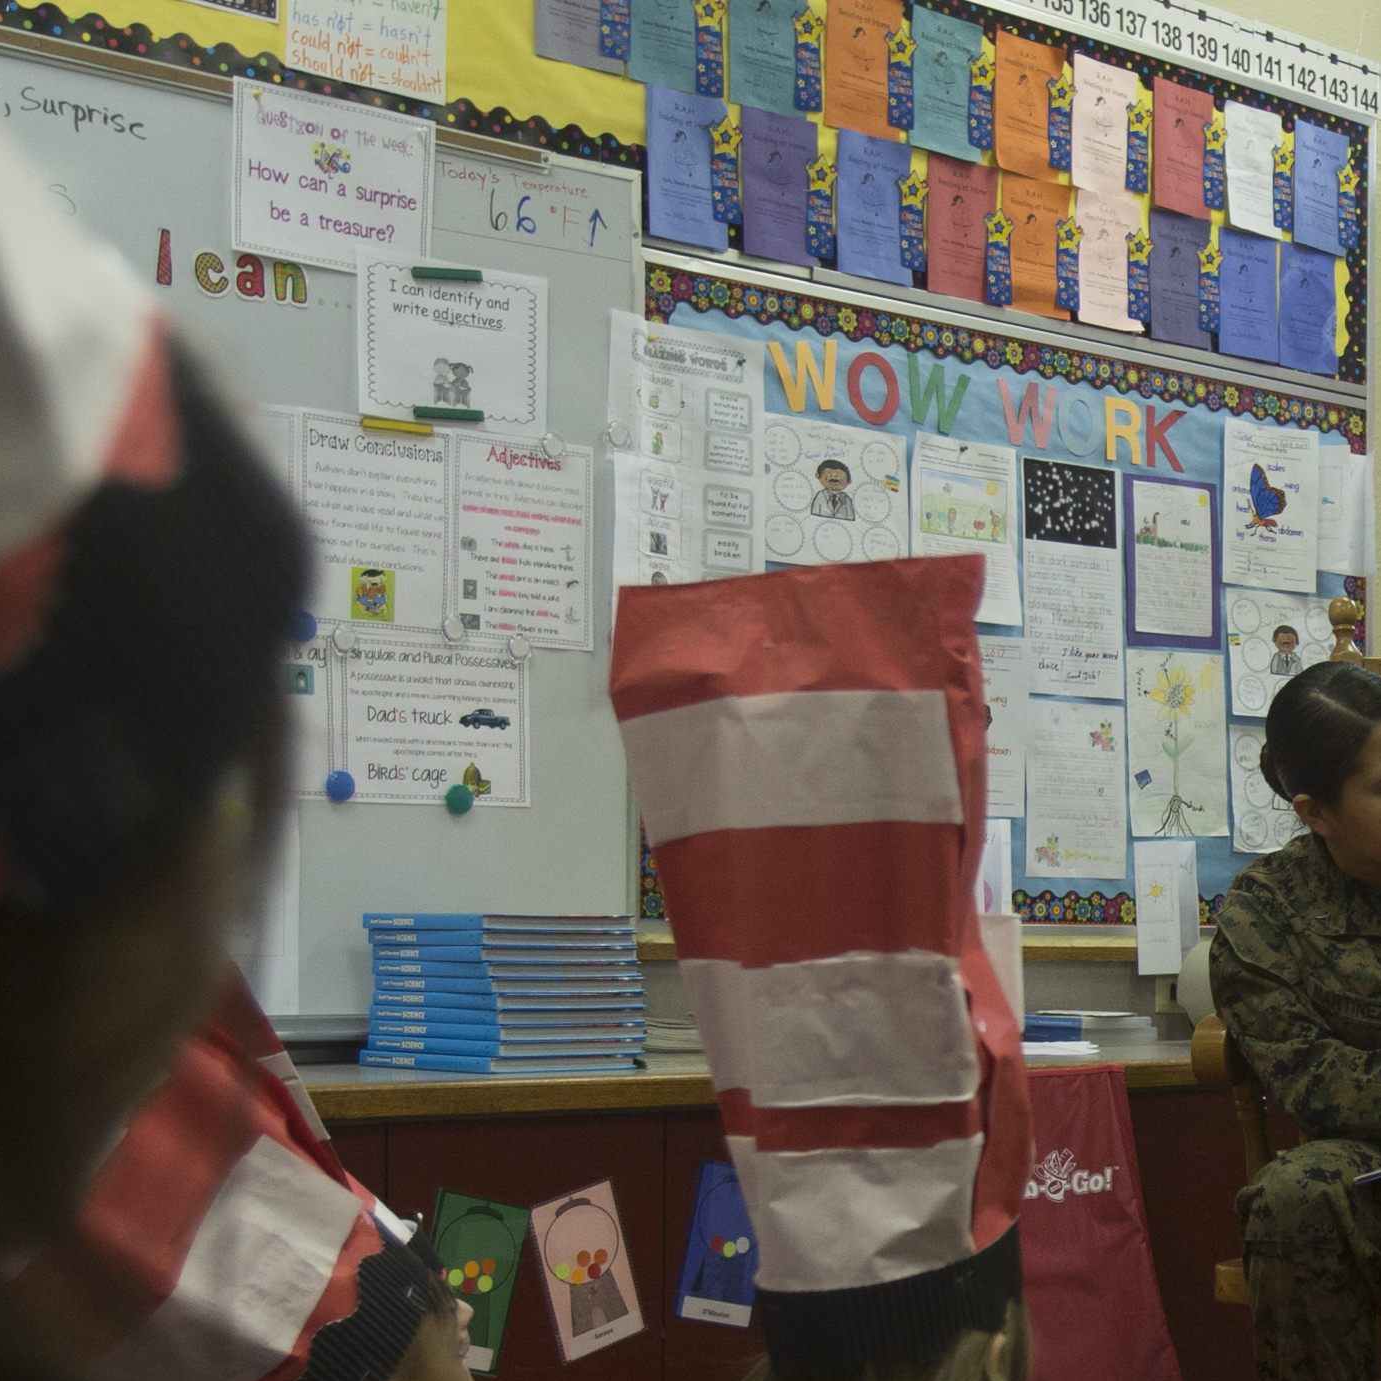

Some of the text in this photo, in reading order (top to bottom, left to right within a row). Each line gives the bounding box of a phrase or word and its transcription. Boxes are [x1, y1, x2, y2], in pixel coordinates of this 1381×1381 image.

[291, 2, 319, 26] has
[380, 16, 432, 47] hasn't
[291, 29, 330, 51] could
[1079, 0, 1110, 28] 136
[1116, 7, 1146, 38] 137
[1151, 19, 1182, 51] 138
[1187, 31, 1218, 62] 139
[1222, 42, 1251, 73] 140
[1256, 52, 1282, 82] 141
[1287, 62, 1317, 93] 142
[1319, 74, 1349, 103] 143
[1352, 84, 1379, 114] 144
[20, 86, 148, 141] Surprise
[248, 158, 418, 211] How can a surprise
[437, 160, 589, 199] Today's Temperature
[270, 201, 396, 244] be a treasure?
[157, 227, 307, 304] I can
[389, 278, 510, 312] I can identify and
[393, 301, 507, 331] write adjectives.
[767, 339, 972, 437] WOW
[996, 373, 1188, 473] WORK
[309, 429, 444, 464] Draw Conclusions
[486, 446, 563, 472] Adjectives
[1284, 482, 1300, 494] wing
[308, 647, 327, 669] ay
[350, 648, 518, 671] Singular and Plural Possessives
[1069, 646, 1083, 658] like
[357, 672, 398, 684] possessive
[412, 675, 434, 686] word
[434, 676, 453, 687] that
[454, 678, 477, 688] shows
[367, 705, 453, 726] Dad's truck
[368, 763, 449, 790] Birds' cage
[594, 1327, 615, 1341] Soraya
